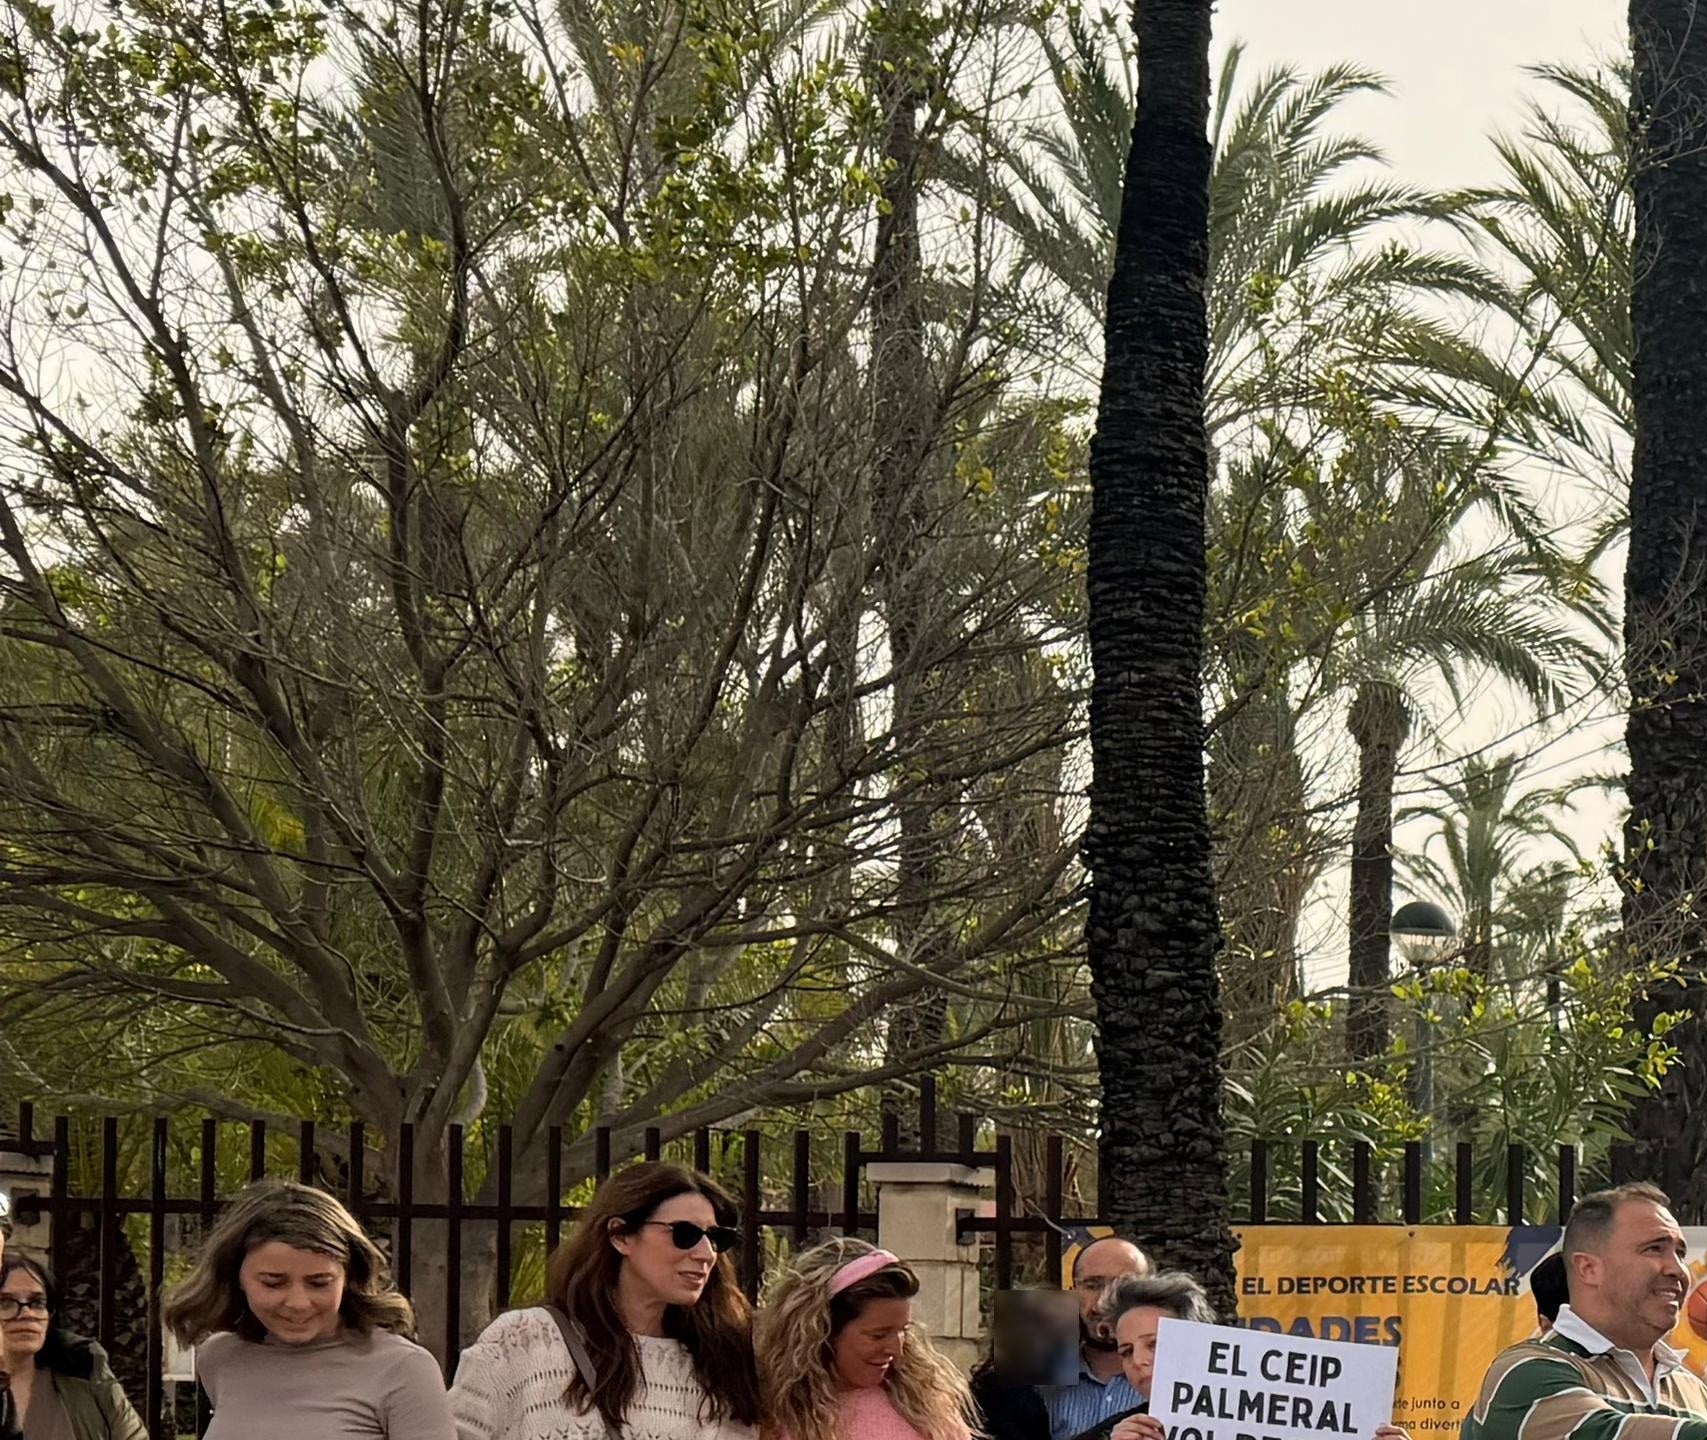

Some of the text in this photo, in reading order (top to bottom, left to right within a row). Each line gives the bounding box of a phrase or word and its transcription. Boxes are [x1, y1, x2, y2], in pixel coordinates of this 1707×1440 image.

[1242, 1275, 1520, 1296] EL DEPORTE ESCOLAR
[1207, 1341, 1342, 1388] EL CEIP
[1171, 1381, 1358, 1434] PALMERAL
[1411, 1397, 1446, 1411] junto
[1450, 1401, 1460, 1409] a
